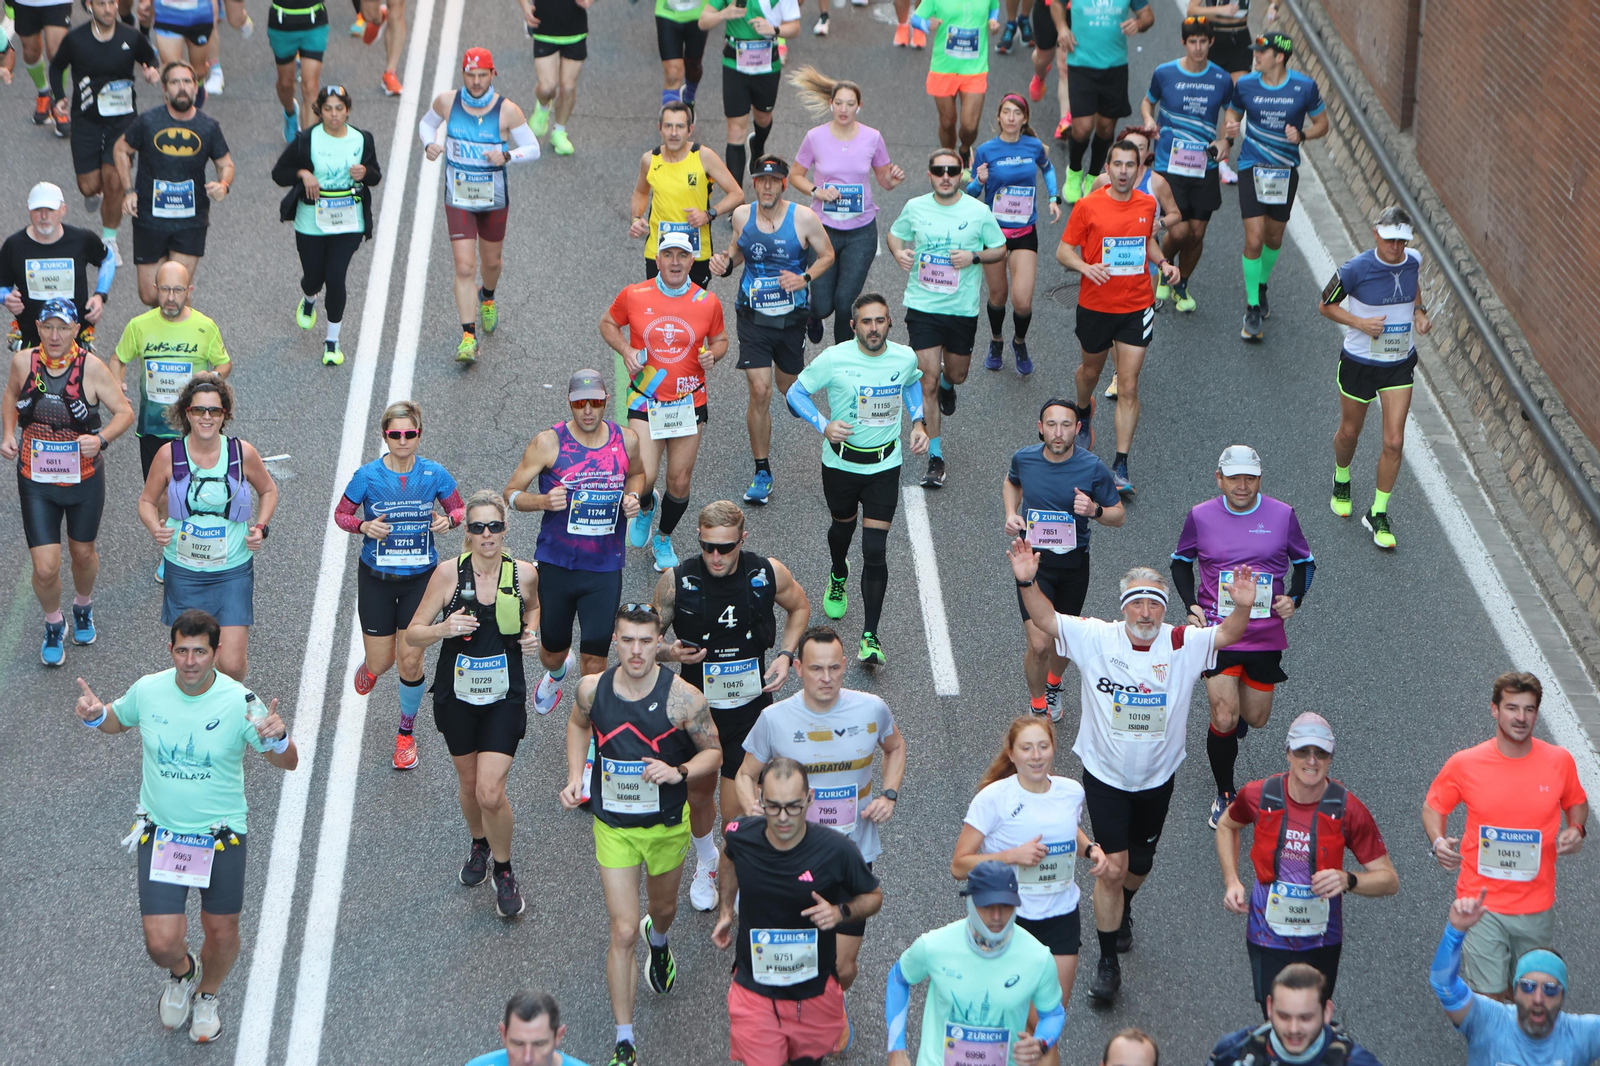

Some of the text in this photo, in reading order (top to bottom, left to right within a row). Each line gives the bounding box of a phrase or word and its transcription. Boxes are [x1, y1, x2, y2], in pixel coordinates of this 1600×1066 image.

[1187, 82, 1215, 91] HYUNDAI
[1264, 96, 1294, 104] HYUNDAI
[168, 183, 190, 191] ZURICH
[1009, 188, 1031, 196] ZURICH
[1118, 239, 1139, 247] ZURICH
[43, 261, 68, 270] ZURICH
[932, 257, 952, 266] ZURIC
[876, 387, 898, 396] ZURICH
[873, 402, 890, 410] 11155
[46, 444, 73, 452] ZURICH
[389, 511, 418, 519] SPORTING
[587, 508, 606, 516] 11744
[1042, 514, 1068, 522] ZURICH
[396, 524, 423, 532] ZURICH
[195, 529, 221, 537] ZURICH
[394, 539, 414, 547] 12713
[191, 543, 211, 552] 10727
[191, 552, 211, 560] NICOLE
[718, 605, 738, 628] 4
[473, 660, 500, 668] ZURICH
[724, 664, 751, 673] ZURICH
[471, 677, 492, 685] 10729
[722, 681, 744, 689] 10476
[1132, 696, 1160, 704] ZURICH
[1128, 713, 1150, 721] 10109
[805, 760, 852, 773] MARATÓN
[160, 770, 212, 781] SEVILLA'24
[617, 782, 639, 791] 10469
[616, 793, 641, 801] GEORGE
[818, 790, 850, 798] ZURICH
[818, 806, 837, 815] 7995
[819, 817, 837, 825] RUUD
[176, 835, 207, 846] ZURICH
[1500, 832, 1533, 842] ZURICH
[173, 851, 192, 862] 6953
[1497, 849, 1521, 858] 10413
[174, 864, 187, 872] ALE
[1039, 863, 1058, 872] 9440
[1038, 874, 1057, 882] ABBIE
[1288, 906, 1307, 914] 9381
[1285, 917, 1310, 925] FARFAN
[773, 933, 809, 943] ZURICH
[774, 952, 793, 961] 9751
[774, 963, 805, 972] FONSECA
[967, 1031, 1003, 1041] ZURICH
[965, 1051, 986, 1060] 6996
